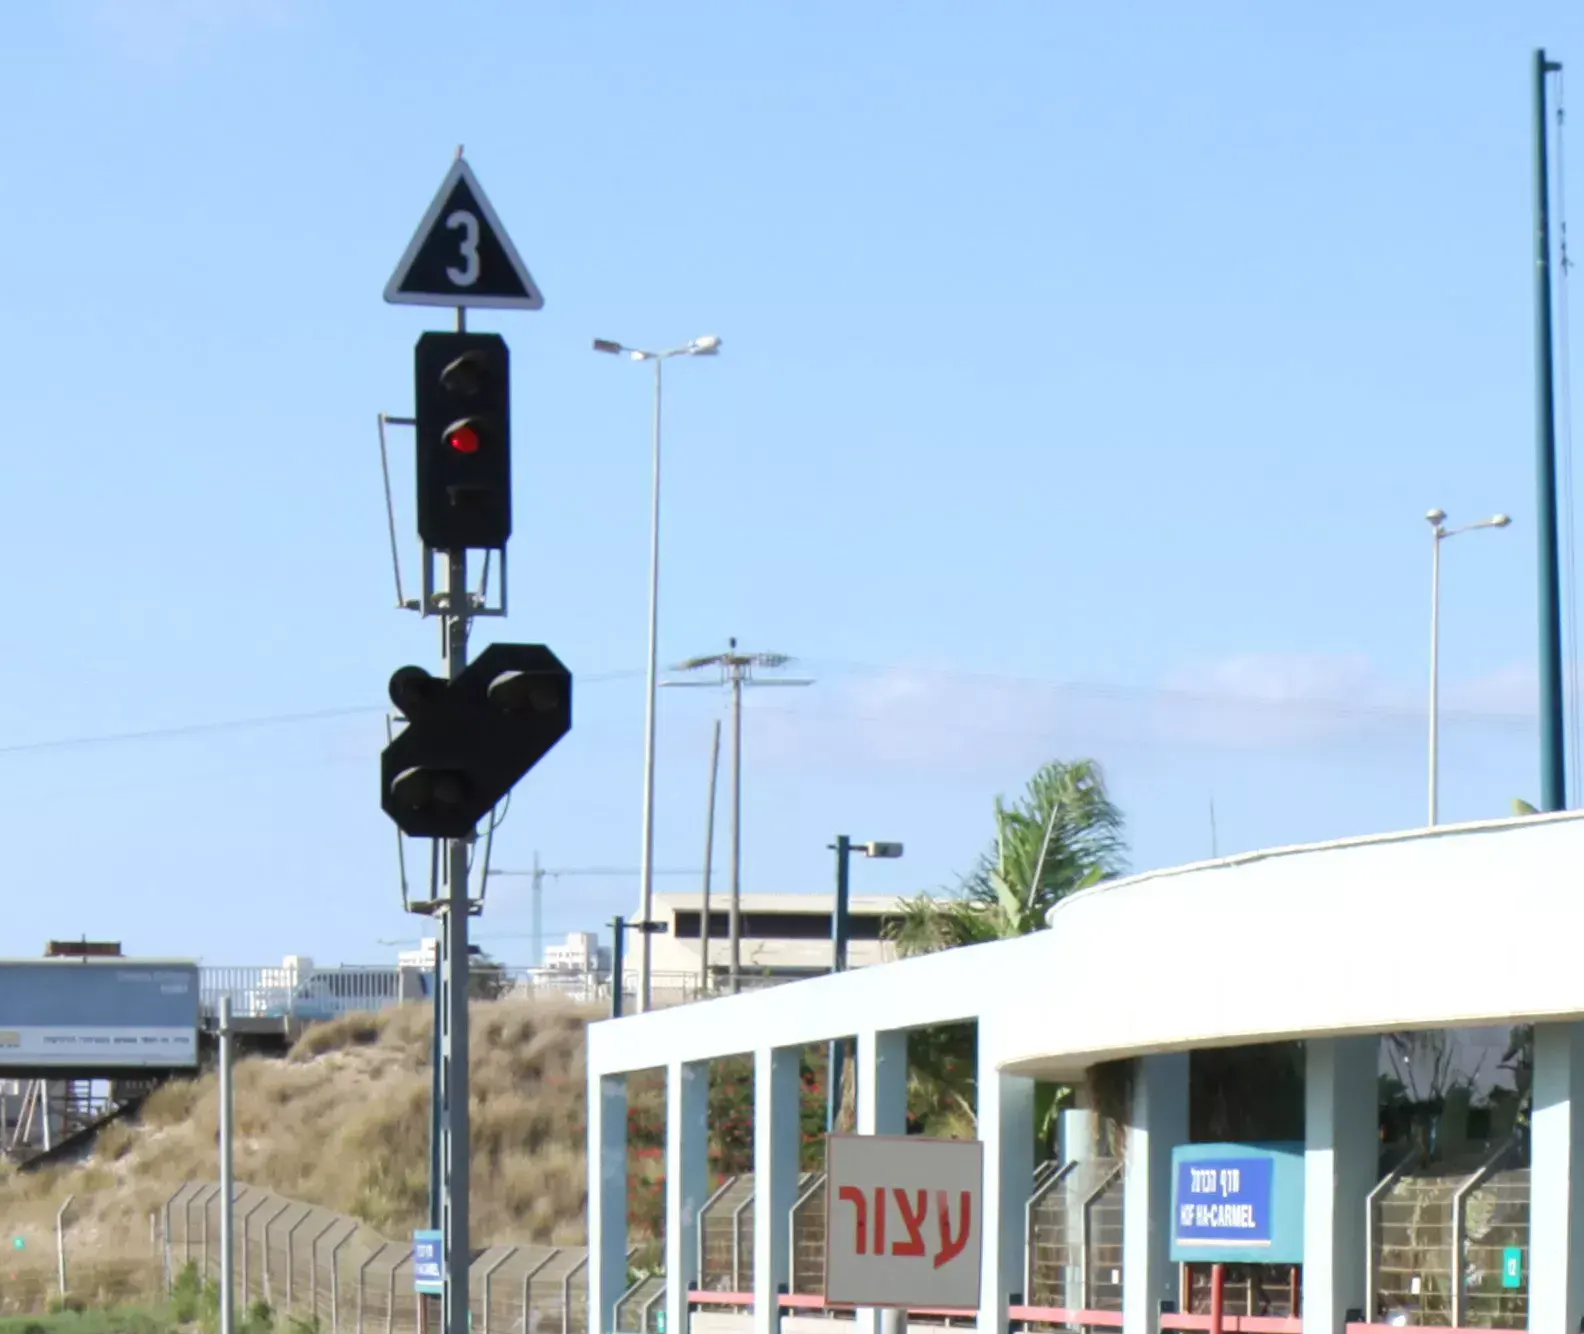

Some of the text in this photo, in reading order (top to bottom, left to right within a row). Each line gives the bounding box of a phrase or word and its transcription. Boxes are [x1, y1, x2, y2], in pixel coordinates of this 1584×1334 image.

[445, 209, 481, 287] 3
[1189, 1166, 1241, 1198] חוף הכרמל
[838, 1185, 972, 1270] עצור
[1180, 1203, 1257, 1228] HOF HA-CARMEL
